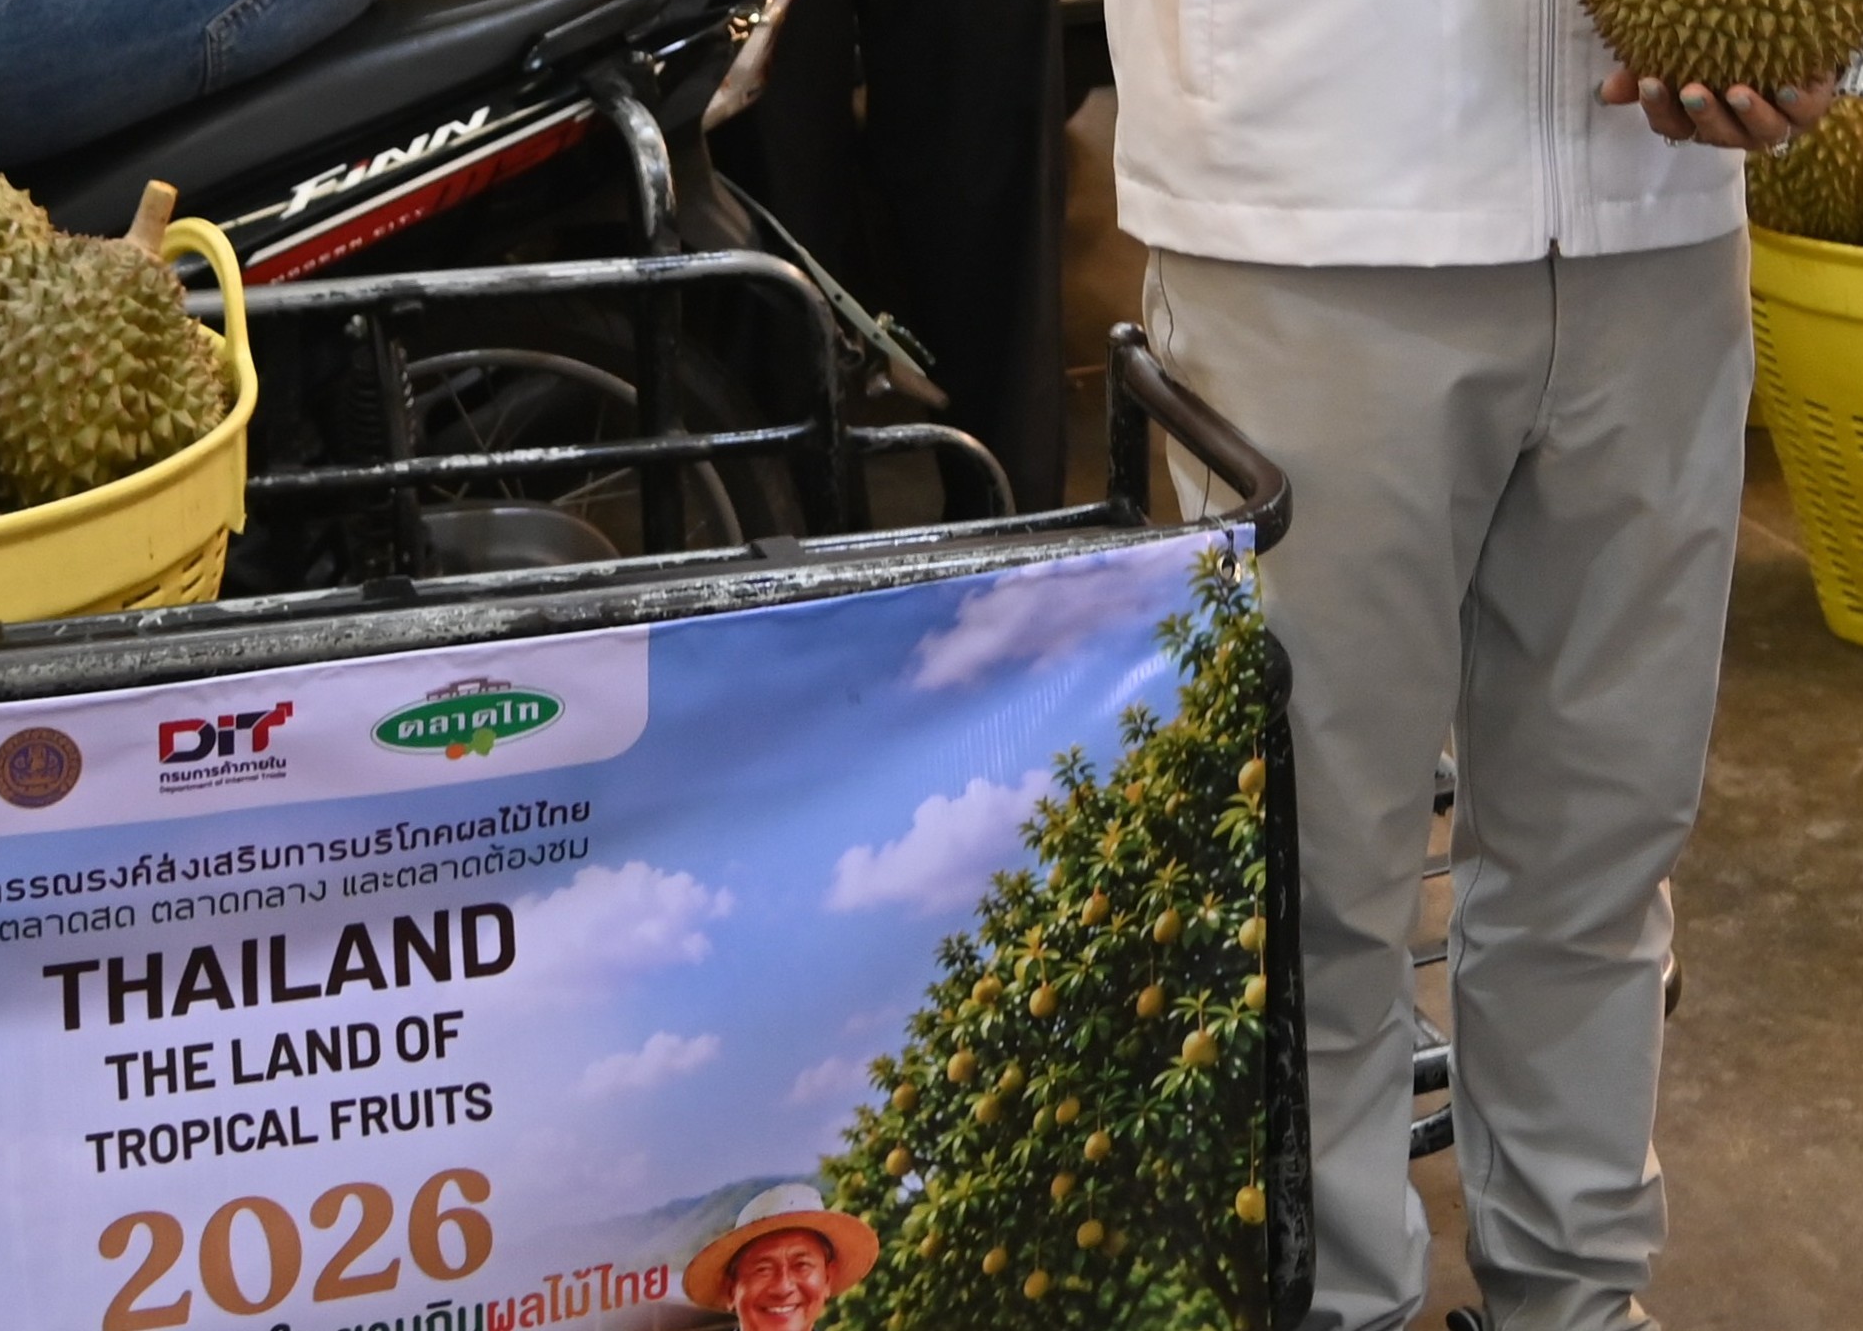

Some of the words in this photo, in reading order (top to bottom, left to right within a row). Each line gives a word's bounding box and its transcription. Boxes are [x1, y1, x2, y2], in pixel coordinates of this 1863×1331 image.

[397, 700, 539, 739] ตลาดไท
[160, 756, 287, 784] กรมการค้าภายใน
[151, 880, 327, 925] ตลาดกลาง
[343, 835, 590, 897] และตลาดต้องชม
[42, 900, 518, 1032] THAILAND
[105, 1041, 216, 1101] THE
[230, 1021, 381, 1085] LAND
[395, 1010, 465, 1059] OF
[86, 1102, 319, 1173] TROPICAL
[330, 1080, 495, 1142] FRUITS
[98, 1167, 494, 1331] 2026
